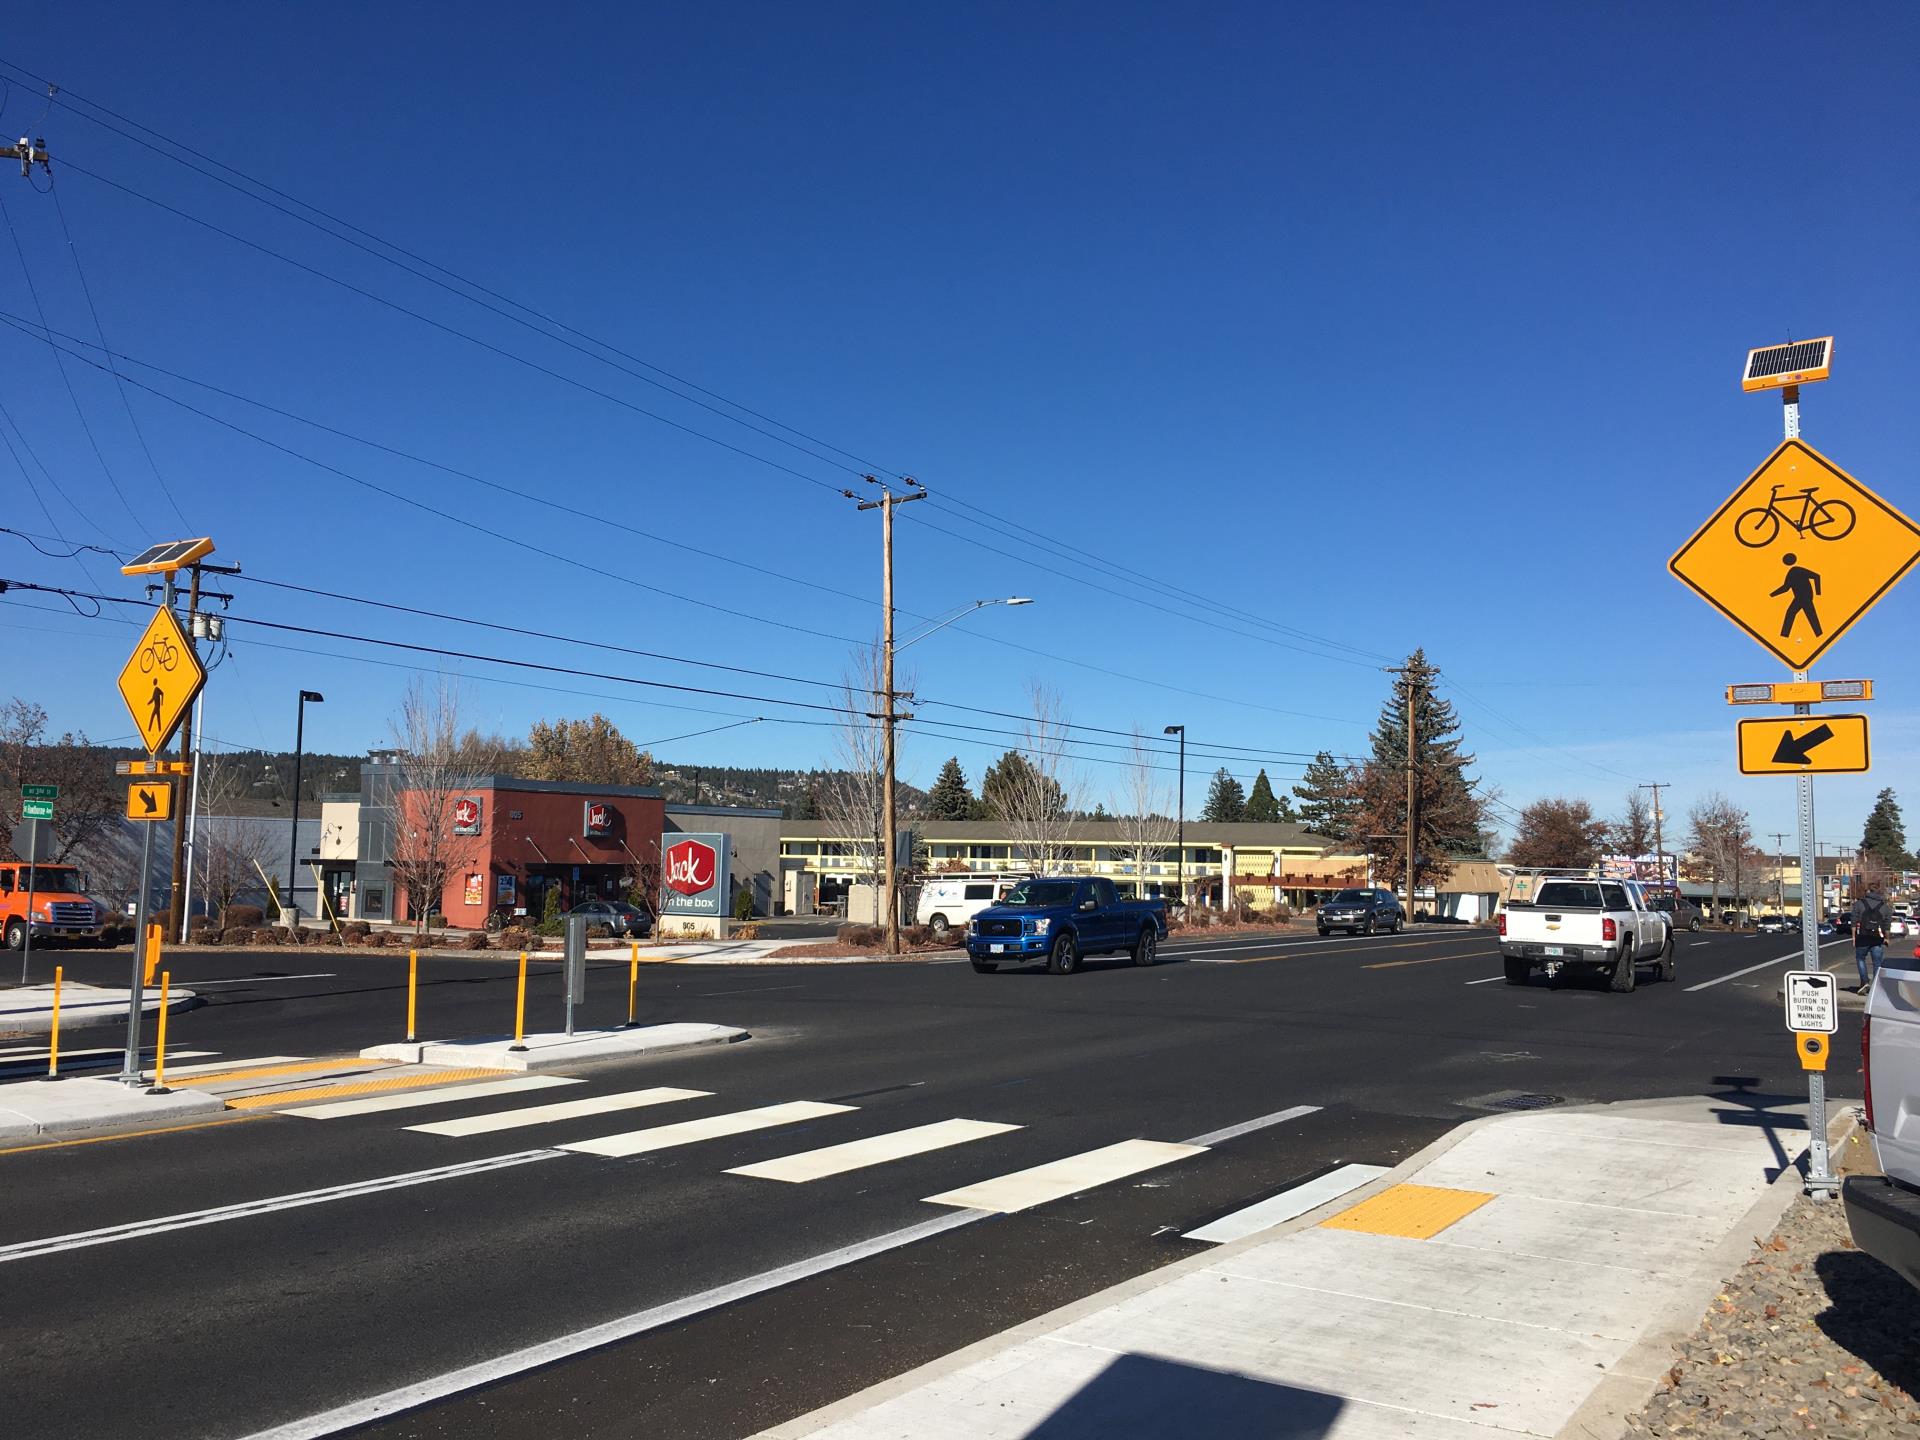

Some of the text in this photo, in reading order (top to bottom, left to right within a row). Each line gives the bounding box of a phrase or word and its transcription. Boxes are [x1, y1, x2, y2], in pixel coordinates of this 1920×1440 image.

[590, 808, 612, 826] Jack
[666, 846, 713, 886] Jack
[676, 897, 693, 906] the
[694, 898, 714, 908] box
[682, 922, 695, 930] 805
